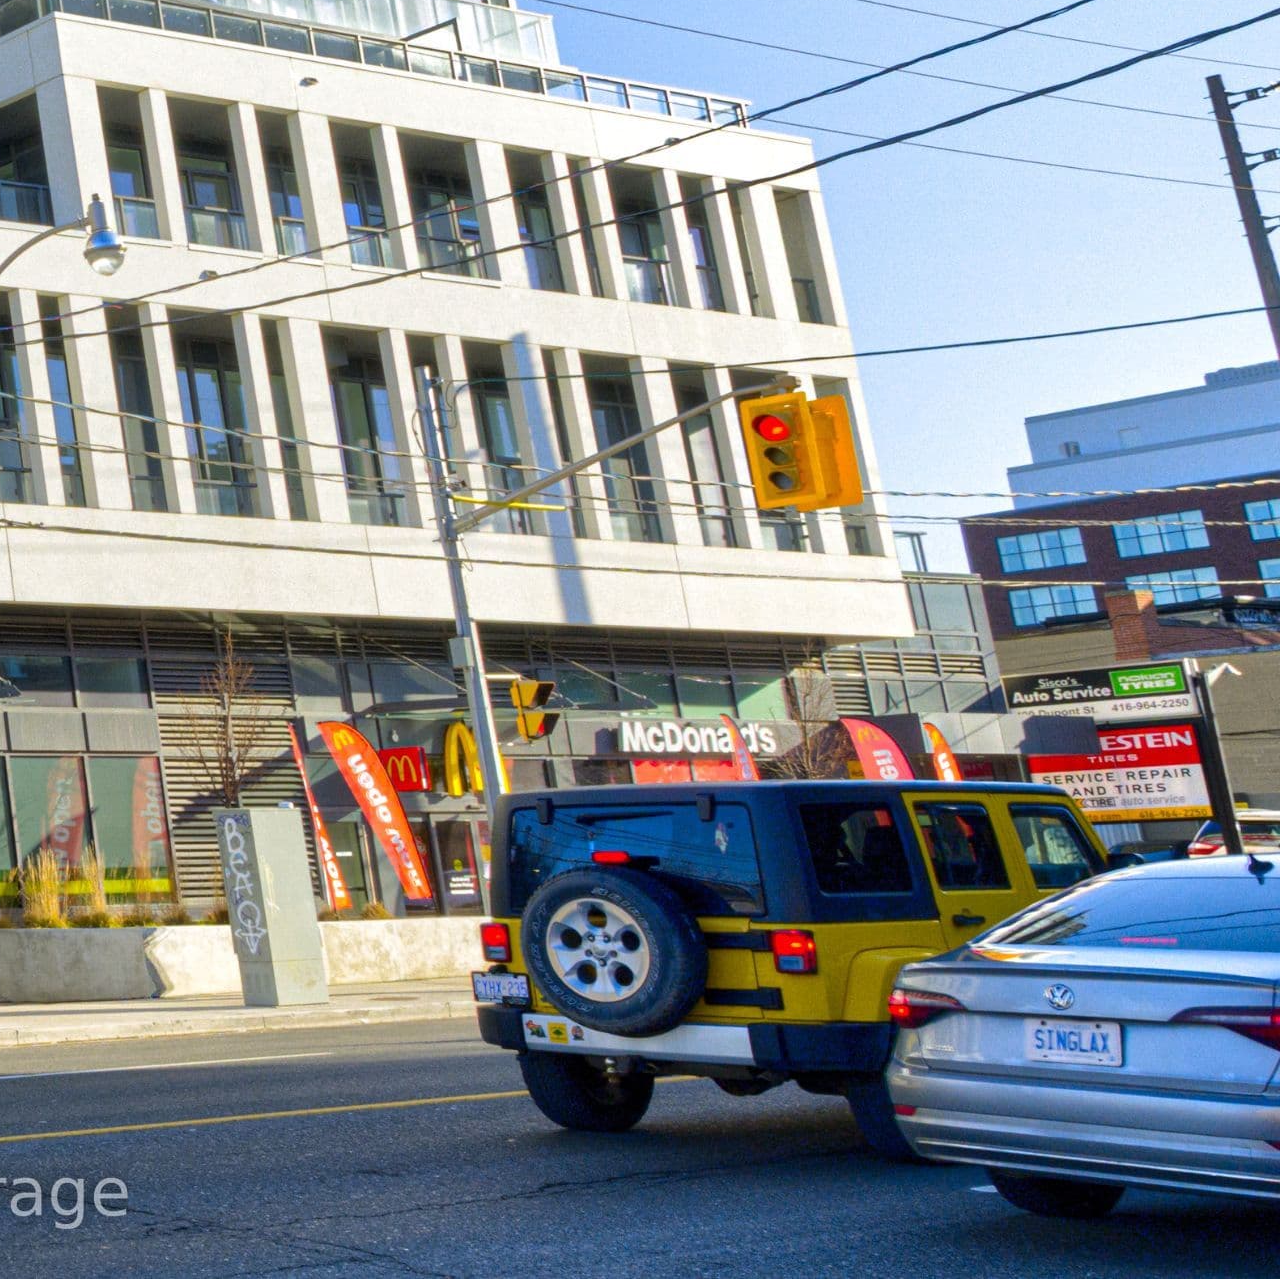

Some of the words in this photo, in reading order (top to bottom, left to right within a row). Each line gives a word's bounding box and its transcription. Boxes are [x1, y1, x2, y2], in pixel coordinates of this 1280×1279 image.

[1038, 677, 1078, 688] Sisco's
[1120, 679, 1176, 690] TYRES
[1012, 688, 1049, 704] Auto
[1053, 685, 1111, 701] Service
[1111, 698, 1189, 712] 416-964-2250
[622, 721, 777, 753] McDonad's
[1100, 731, 1193, 751] ESTEIN
[1087, 753, 1139, 764] TIRES
[1042, 771, 1115, 785] SERVICE
[1127, 767, 1192, 781] REPAIR
[347, 753, 392, 823] open
[1072, 785, 1107, 798] AND
[1115, 783, 1167, 795] TIRES
[1147, 795, 1186, 806] service
[1034, 1029, 1110, 1053] SINGLAX
